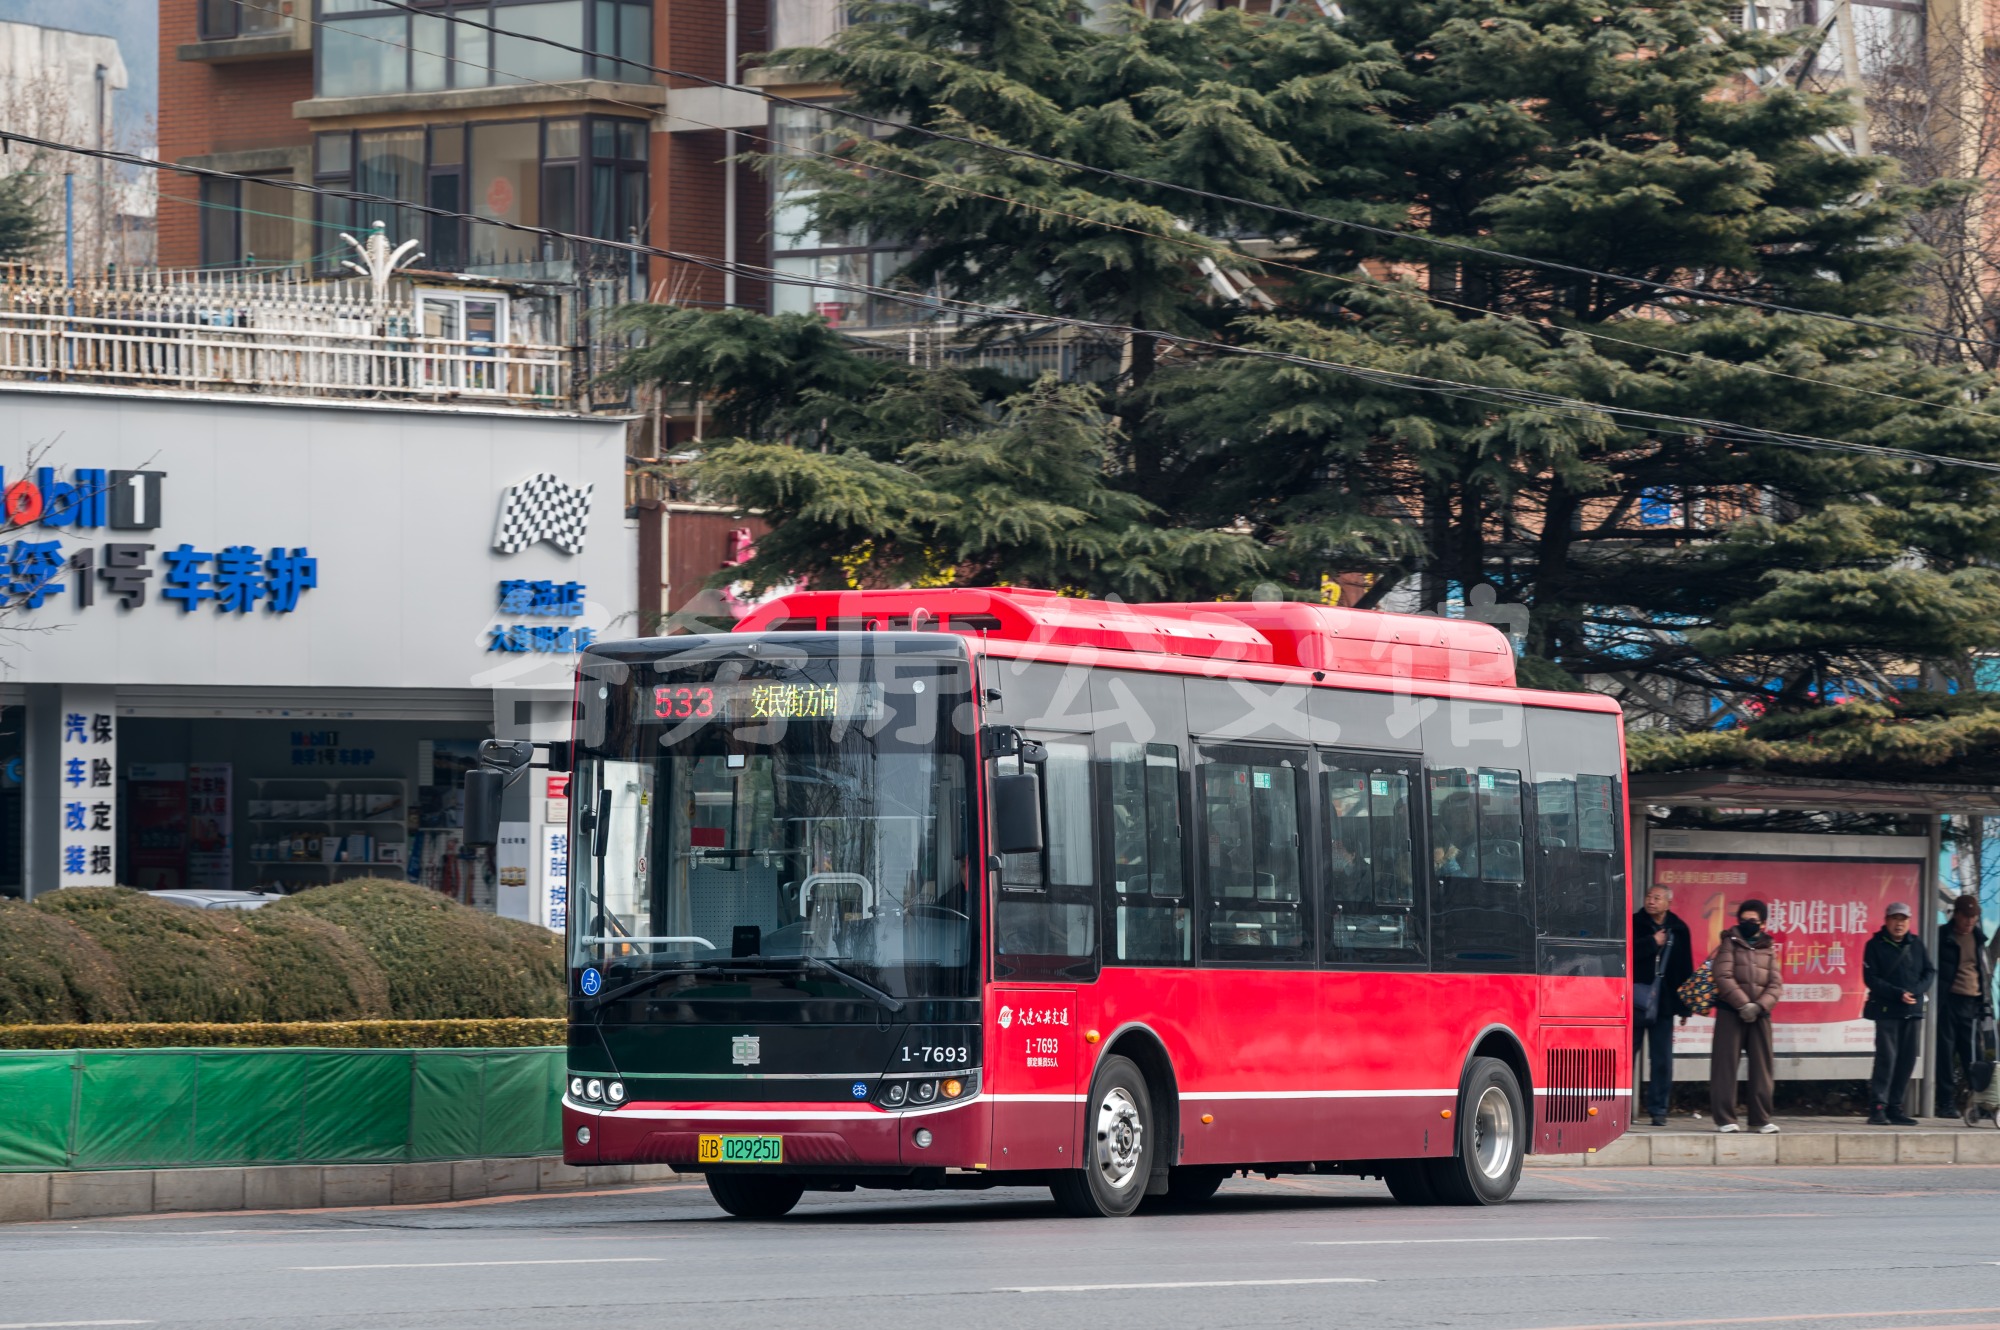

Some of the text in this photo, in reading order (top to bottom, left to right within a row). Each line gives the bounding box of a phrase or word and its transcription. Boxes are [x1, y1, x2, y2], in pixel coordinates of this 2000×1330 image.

[0, 466, 106, 527] obil
[0, 540, 318, 613] 孚1号车养护
[499, 580, 586, 615] 臻选店
[654, 688, 714, 718] 533
[751, 684, 838, 718] 安民街方向
[65, 713, 88, 875] 汽车改装
[90, 713, 113, 875] 保险定损
[1766, 899, 1868, 934] 康贝佳口腔
[901, 1046, 967, 1063] 1-7693
[1025, 1038, 1058, 1054] 1-7693
